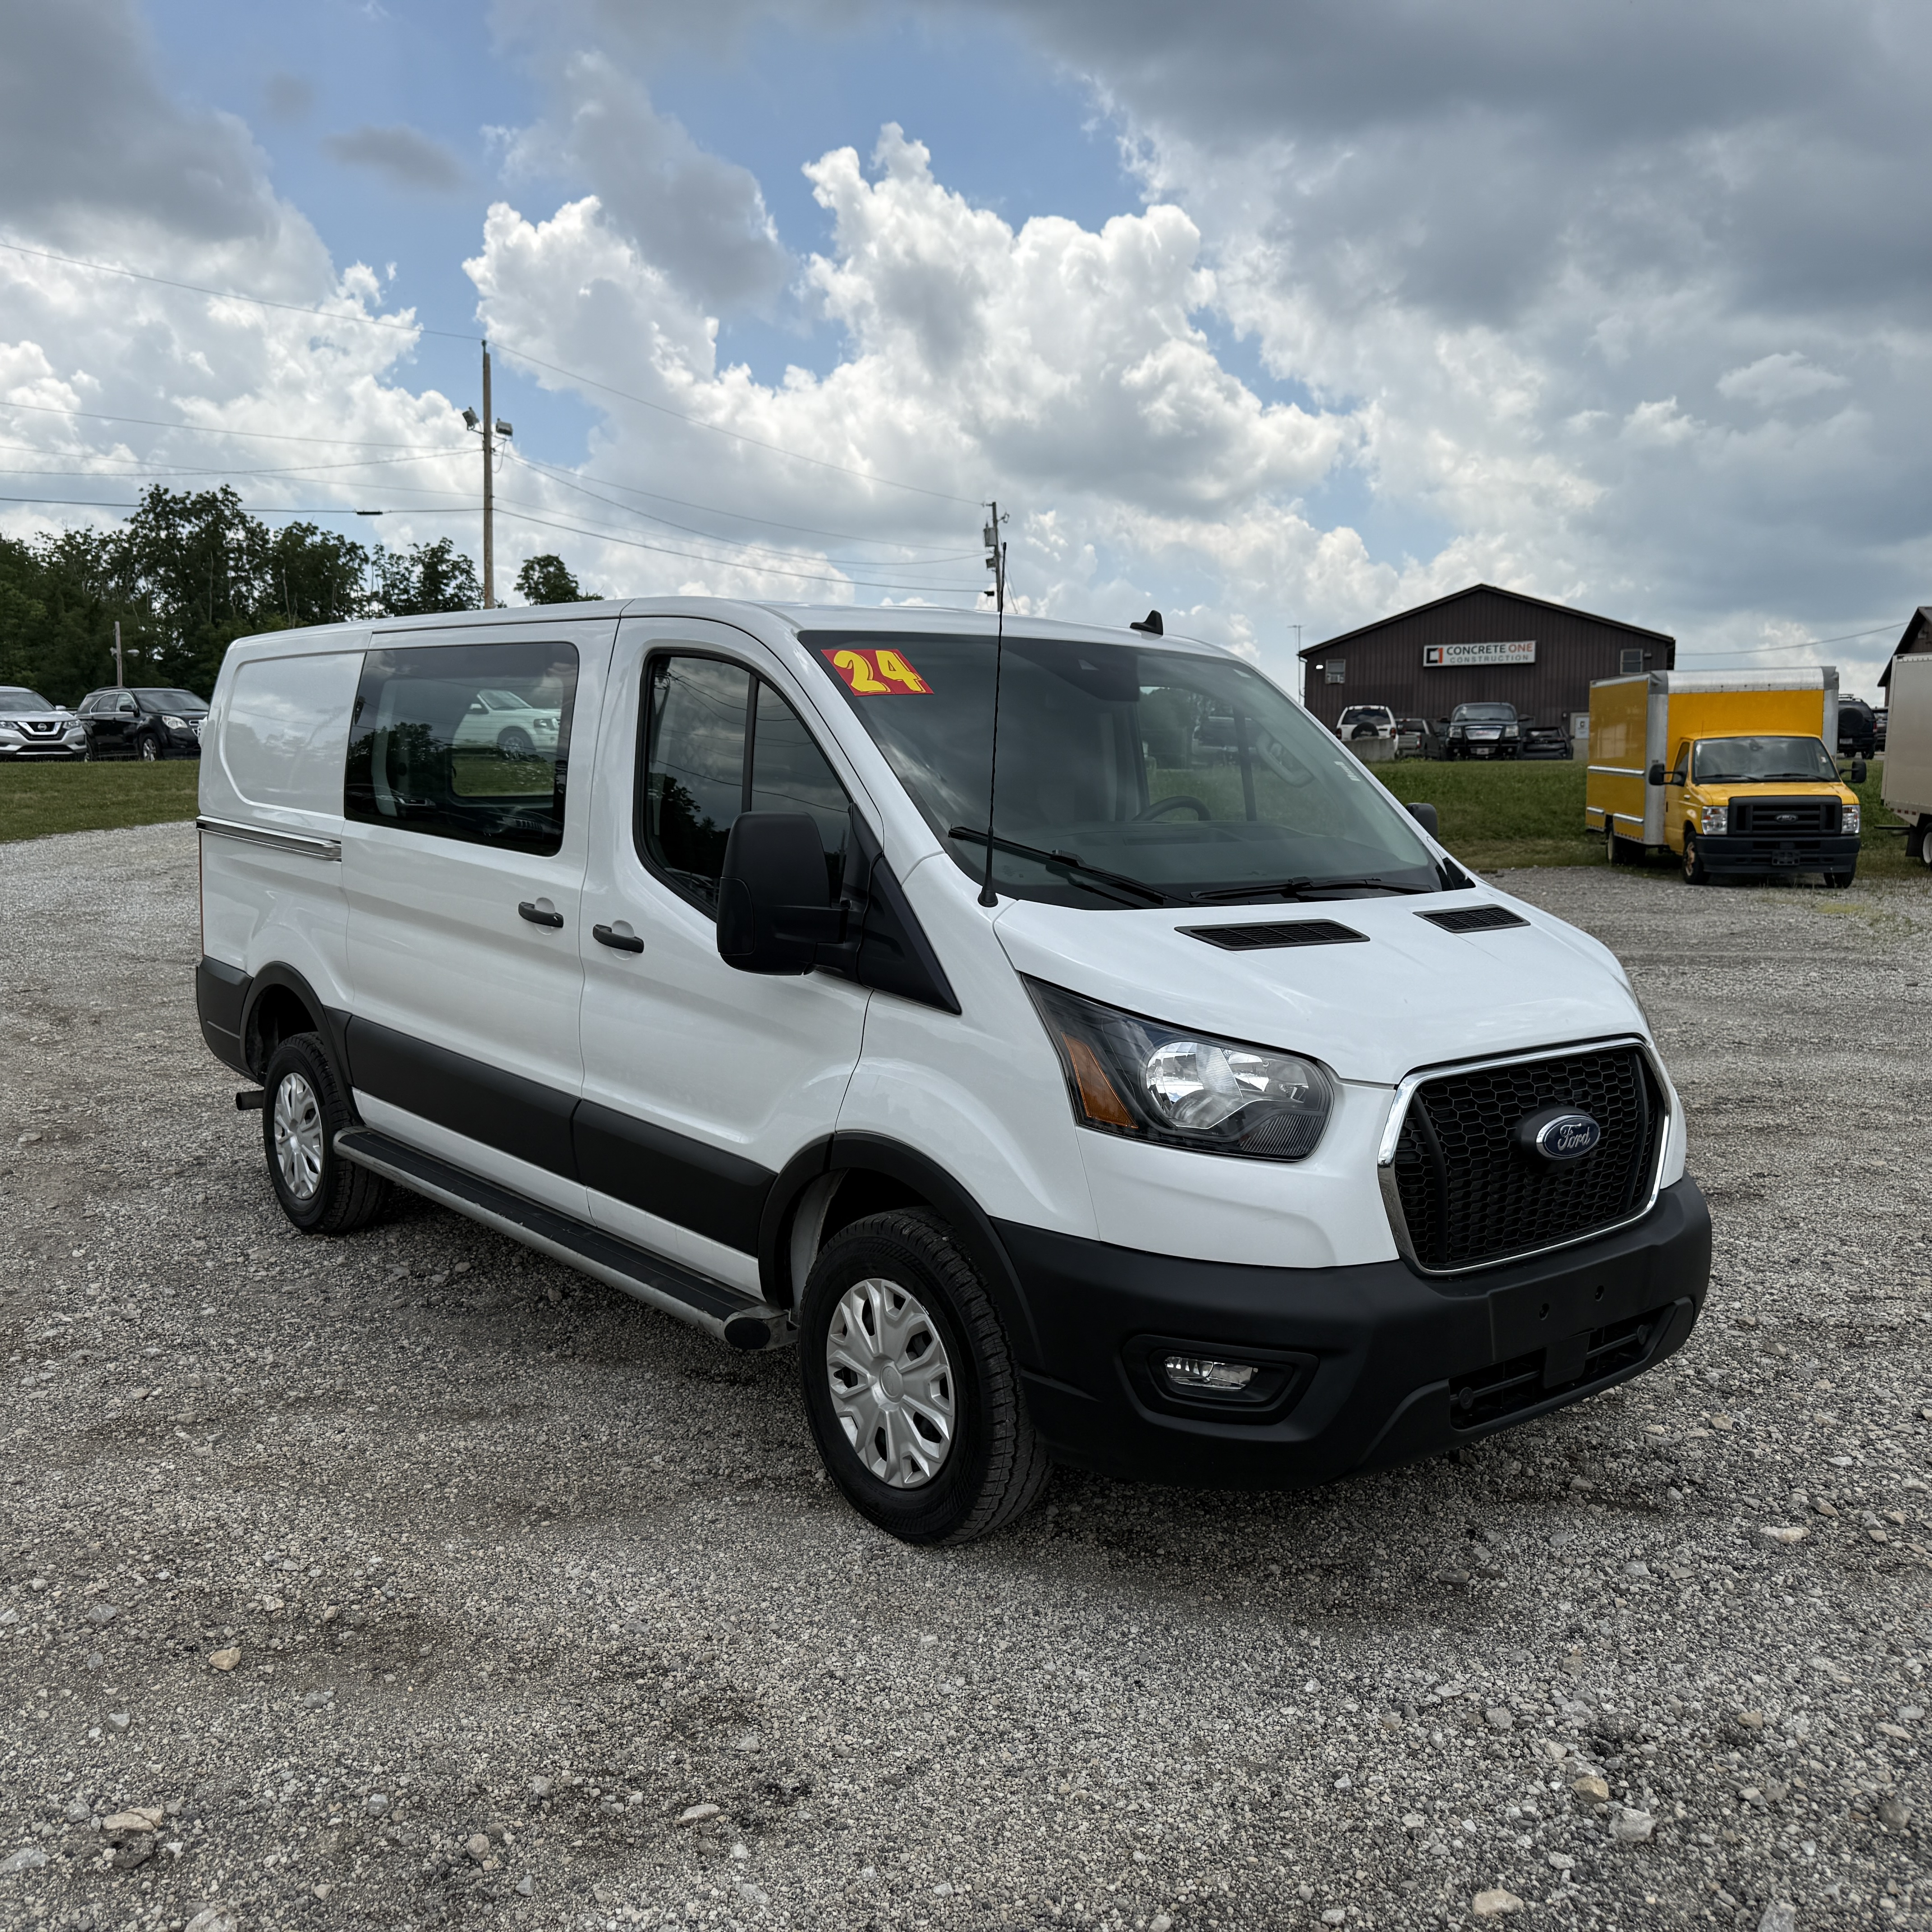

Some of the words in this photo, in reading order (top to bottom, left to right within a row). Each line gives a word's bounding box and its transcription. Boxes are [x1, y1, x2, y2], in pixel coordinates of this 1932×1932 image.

[1446, 645, 1506, 655] CONCRETE
[1508, 643, 1533, 653] ONE
[1449, 654, 1528, 663] CONSTRUCTION
[833, 650, 926, 693] 24
[1557, 1123, 1590, 1150] Ford
